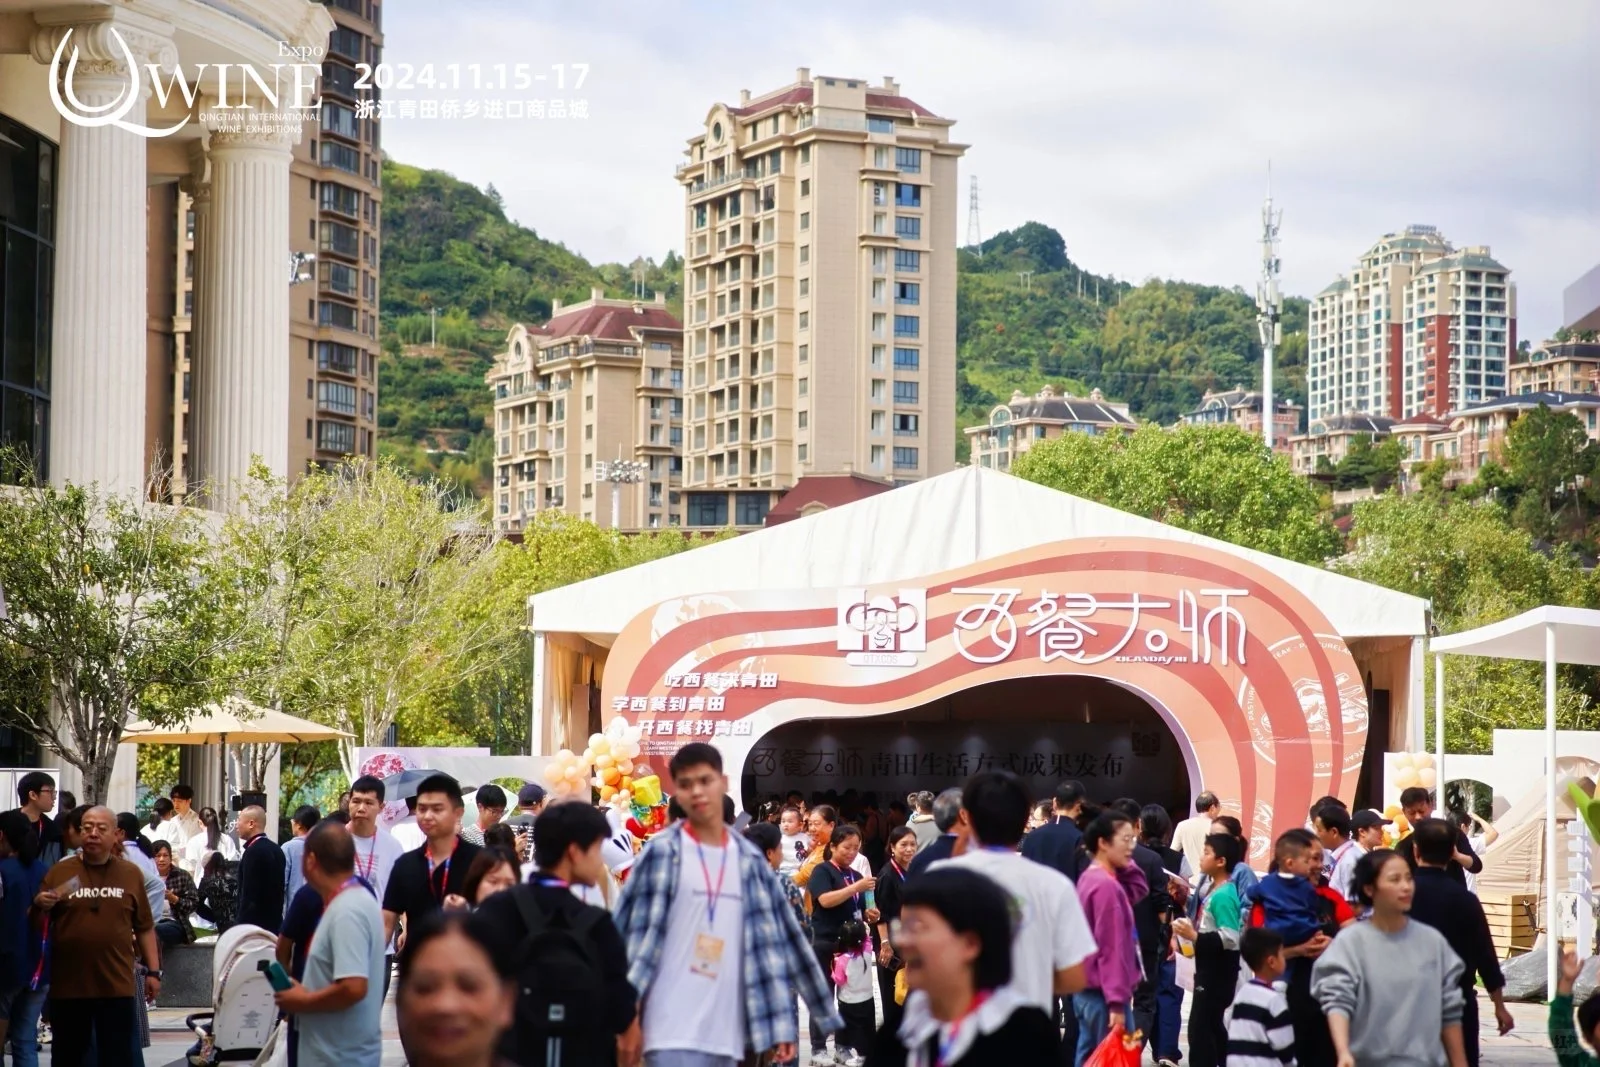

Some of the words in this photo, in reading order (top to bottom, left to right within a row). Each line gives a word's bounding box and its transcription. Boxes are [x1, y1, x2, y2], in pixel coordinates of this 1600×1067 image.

[950, 587, 1250, 666] 西餐大师
[611, 696, 726, 713] 学西餐到青田
